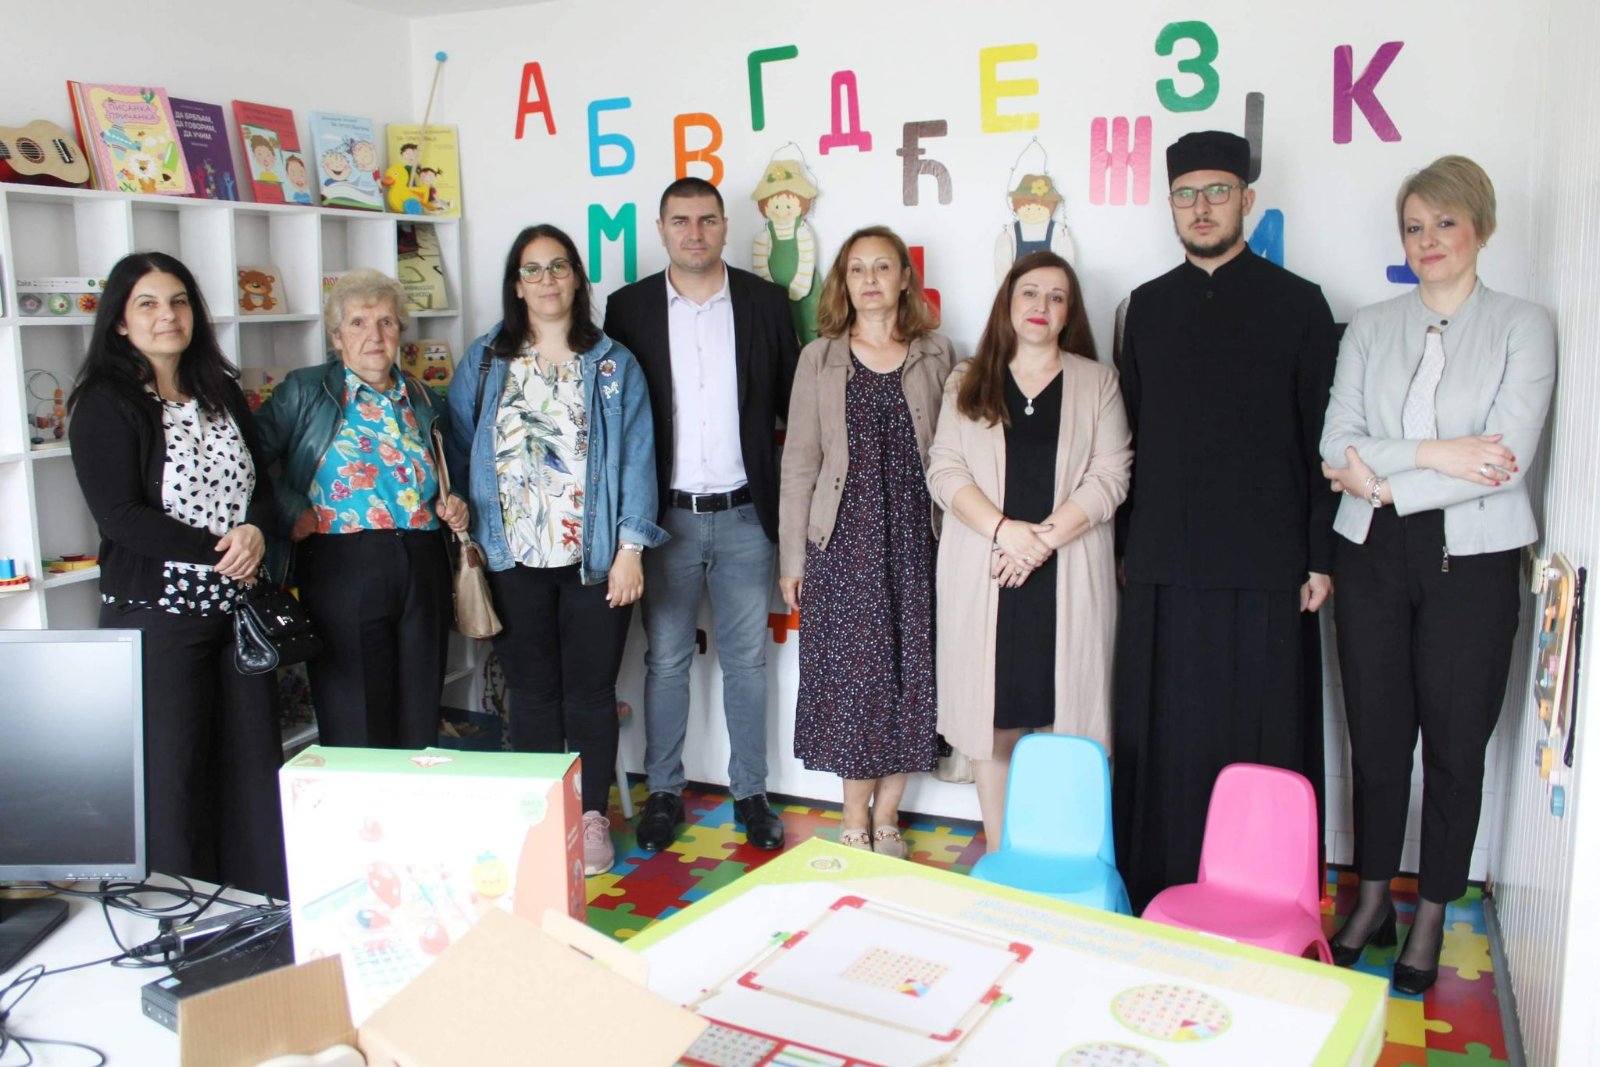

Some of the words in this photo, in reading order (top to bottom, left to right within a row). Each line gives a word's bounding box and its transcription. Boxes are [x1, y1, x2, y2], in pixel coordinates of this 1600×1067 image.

[747, 44, 799, 132] Г
[819, 70, 873, 155] Д
[587, 96, 636, 177] Б
[1090, 116, 1152, 206] Ж
